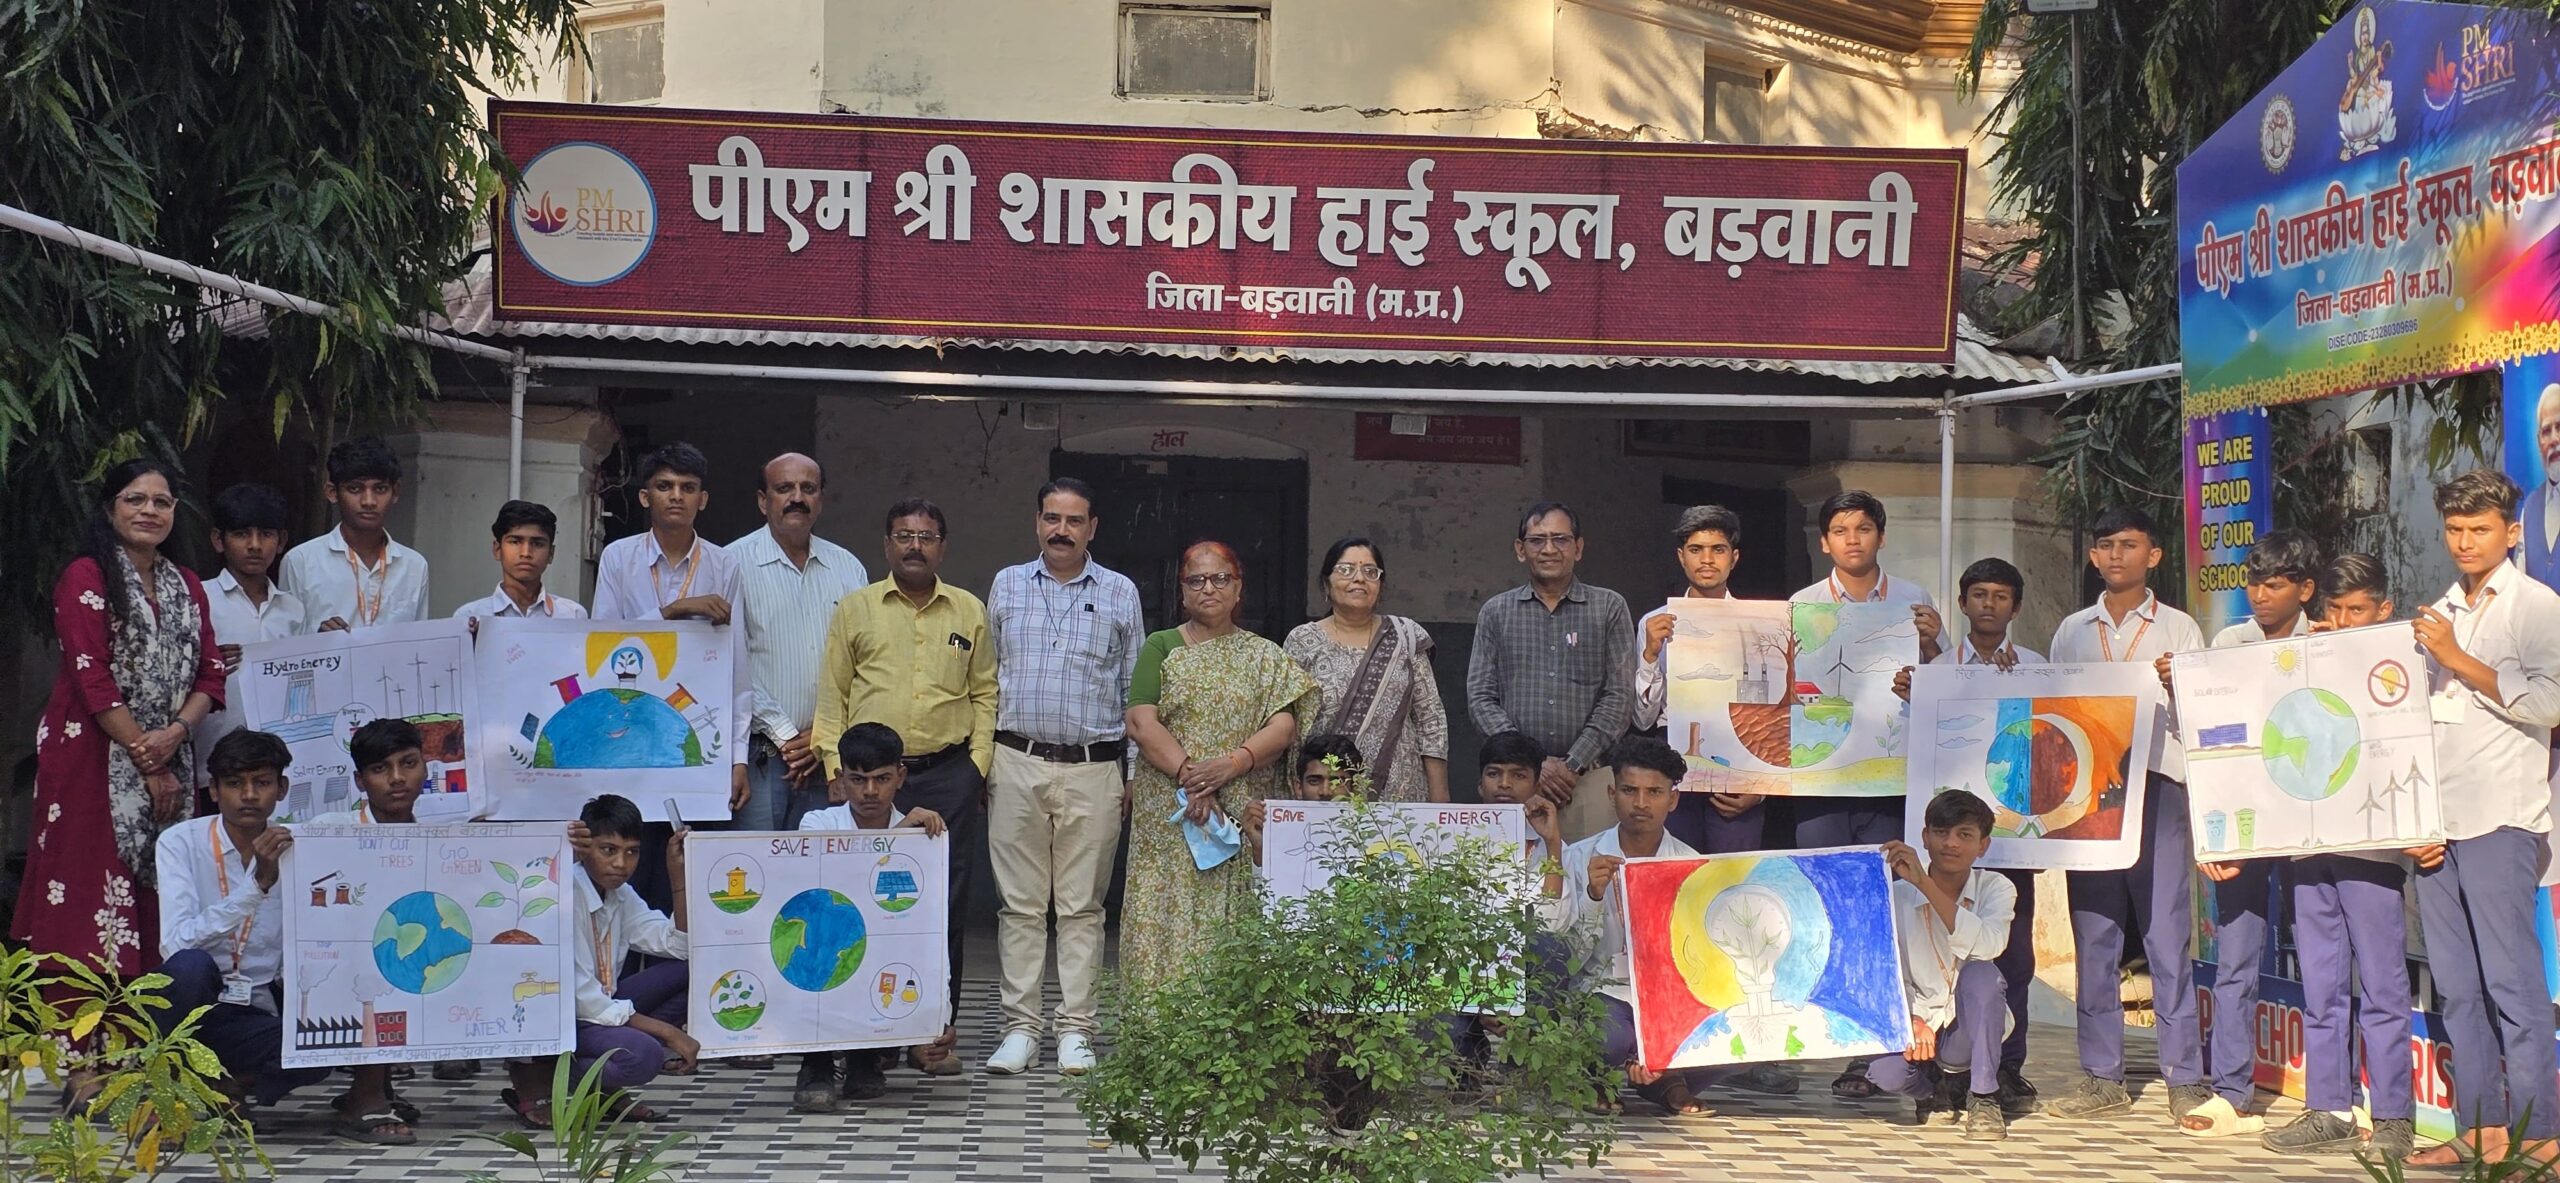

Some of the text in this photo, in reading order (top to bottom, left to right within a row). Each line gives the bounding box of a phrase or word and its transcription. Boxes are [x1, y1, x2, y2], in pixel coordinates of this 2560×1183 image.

[2462, 19, 2491, 57] PM
[2462, 41, 2515, 91] SHRI
[577, 187, 614, 209] PM
[576, 208, 646, 233] SHRI
[689, 136, 1917, 292] पीएम श्री शासकीय हाई स्कूल, बड़वानी
[2197, 139, 2560, 293] पीएम श्री शासकीय हाई स्कूल, बड़वा
[2328, 335, 2346, 349] DISE
[2197, 436, 2253, 467] WE ARE
[2201, 479, 2250, 507] PROUD
[2200, 521, 2255, 549] OF OUR
[2200, 565, 2249, 591] SCHOO
[262, 656, 341, 677] Hydro Energy
[1272, 808, 1502, 825] SAVE ENERGY
[390, 838, 410, 850] CUT
[771, 836, 896, 857] SAVE ENERGY
[379, 855, 414, 868] TREES
[441, 859, 481, 875] GREEN
[448, 1005, 484, 1024] SAVE
[465, 1018, 509, 1038] WATER
